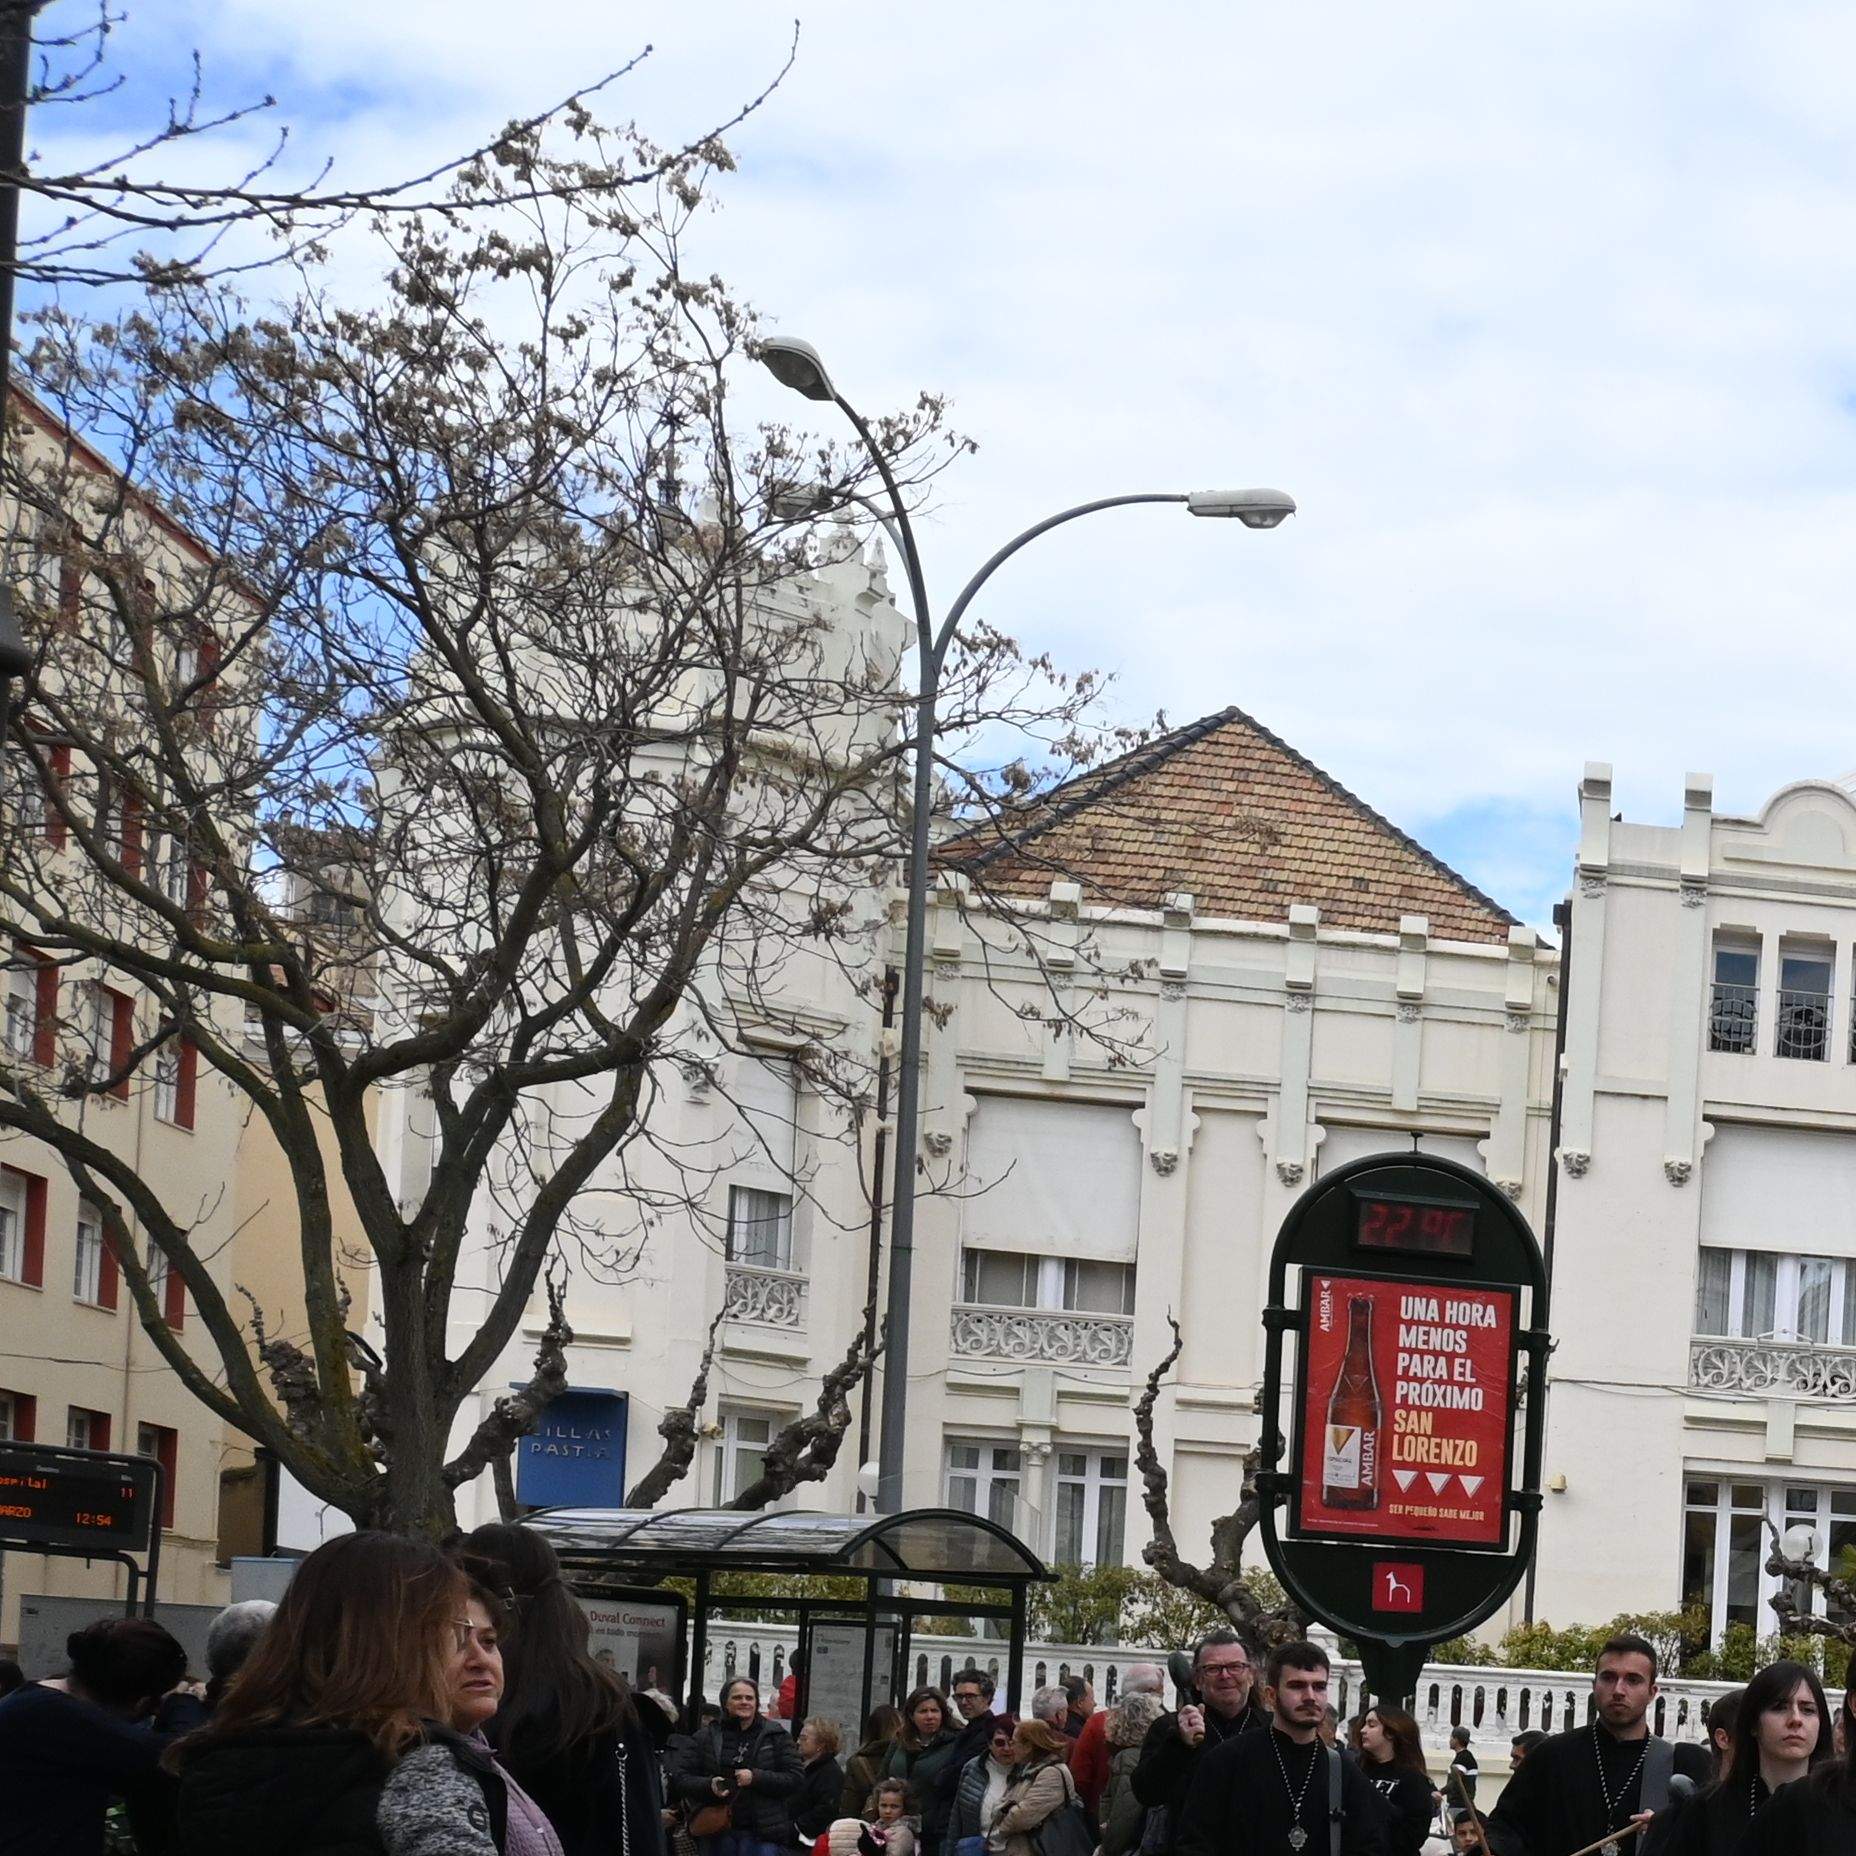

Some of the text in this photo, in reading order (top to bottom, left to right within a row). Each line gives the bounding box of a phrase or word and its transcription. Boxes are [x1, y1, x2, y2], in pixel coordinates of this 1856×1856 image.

[1320, 1290, 1331, 1333] AMBAR
[1401, 1296, 1497, 1329] UNA HORA
[1399, 1324, 1467, 1353] MENOS
[1397, 1353, 1476, 1382] PARA EL
[1395, 1380, 1483, 1411] PRÓXIMO
[1394, 1409, 1433, 1434] SAN
[1361, 1431, 1376, 1486] AMBAR
[1392, 1435, 1478, 1467] LORENZO
[121, 1487, 134, 1498] 11
[75, 1512, 113, 1526] 12:54
[1389, 1504, 1403, 1514] SER
[1439, 1508, 1457, 1519] SABE
[1459, 1510, 1485, 1521] MEJOR
[623, 1613, 667, 1629] Connect
